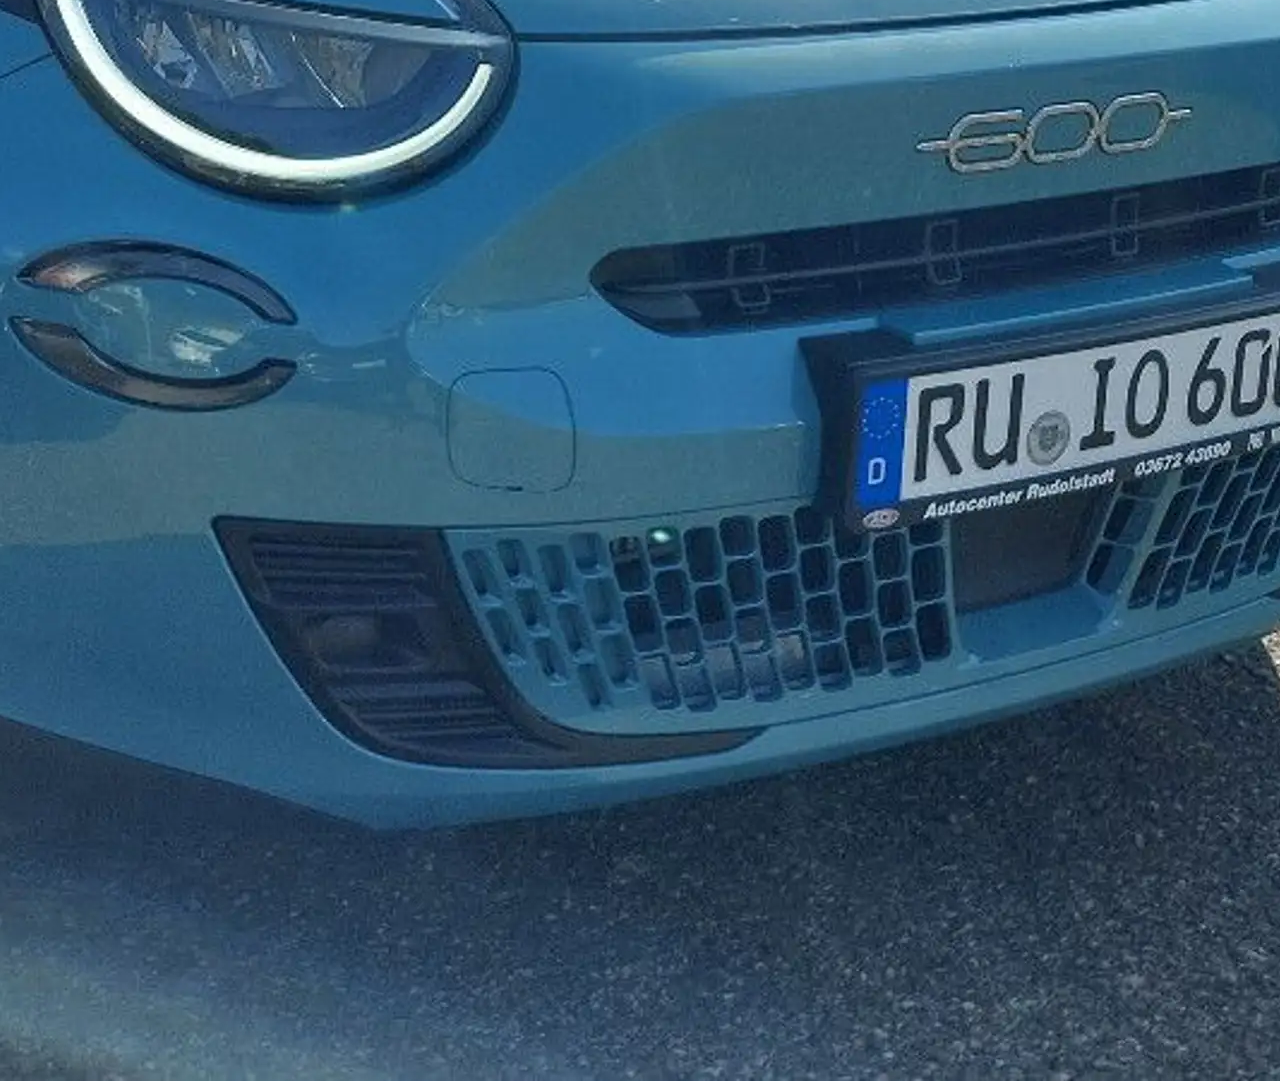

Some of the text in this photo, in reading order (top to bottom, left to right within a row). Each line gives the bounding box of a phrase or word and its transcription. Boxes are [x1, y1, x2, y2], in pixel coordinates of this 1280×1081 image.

[913, 373, 1025, 482] RU
[1079, 348, 1170, 451] IO
[867, 457, 887, 485] D
[923, 490, 1024, 519] Autocenter
[1026, 469, 1116, 501] Rudolstadt
[1134, 452, 1183, 477] 03672
